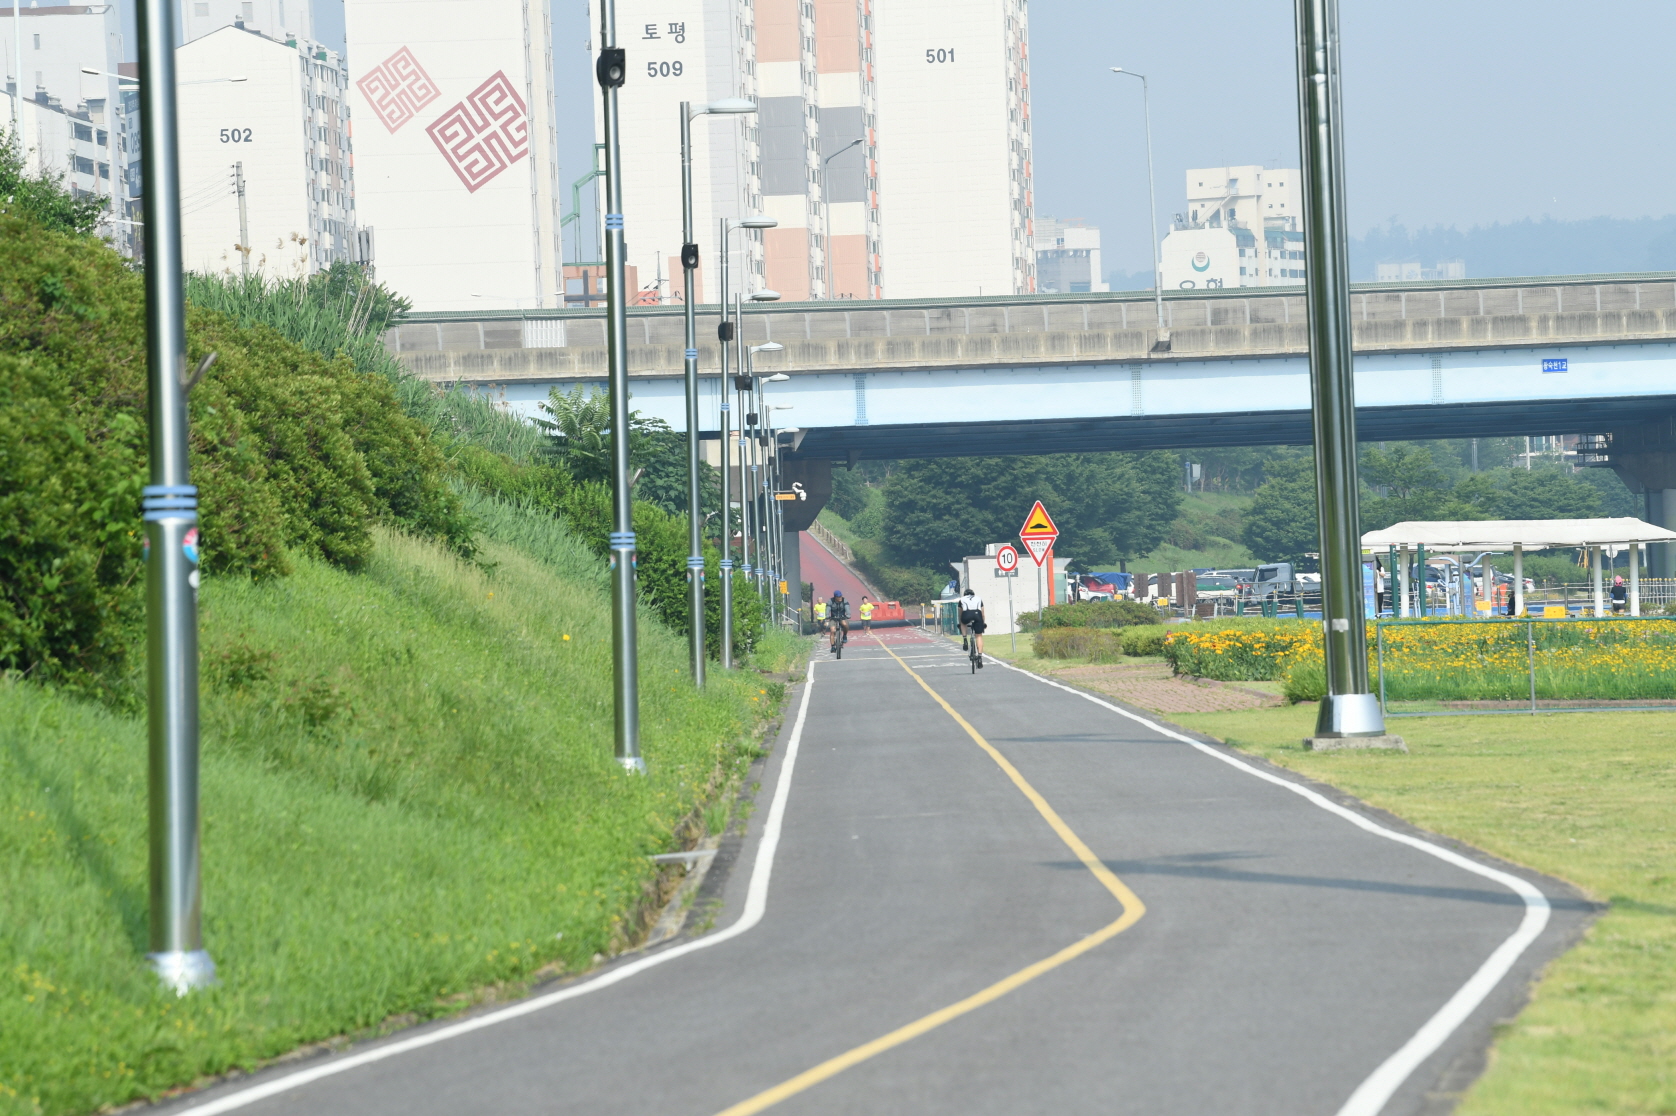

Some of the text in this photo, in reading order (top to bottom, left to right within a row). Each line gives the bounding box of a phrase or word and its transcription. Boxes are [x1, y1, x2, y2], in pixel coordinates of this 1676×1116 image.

[926, 48, 954, 63] 501
[648, 61, 682, 78] 509
[219, 128, 253, 143] 502
[1002, 552, 1013, 564] 10
